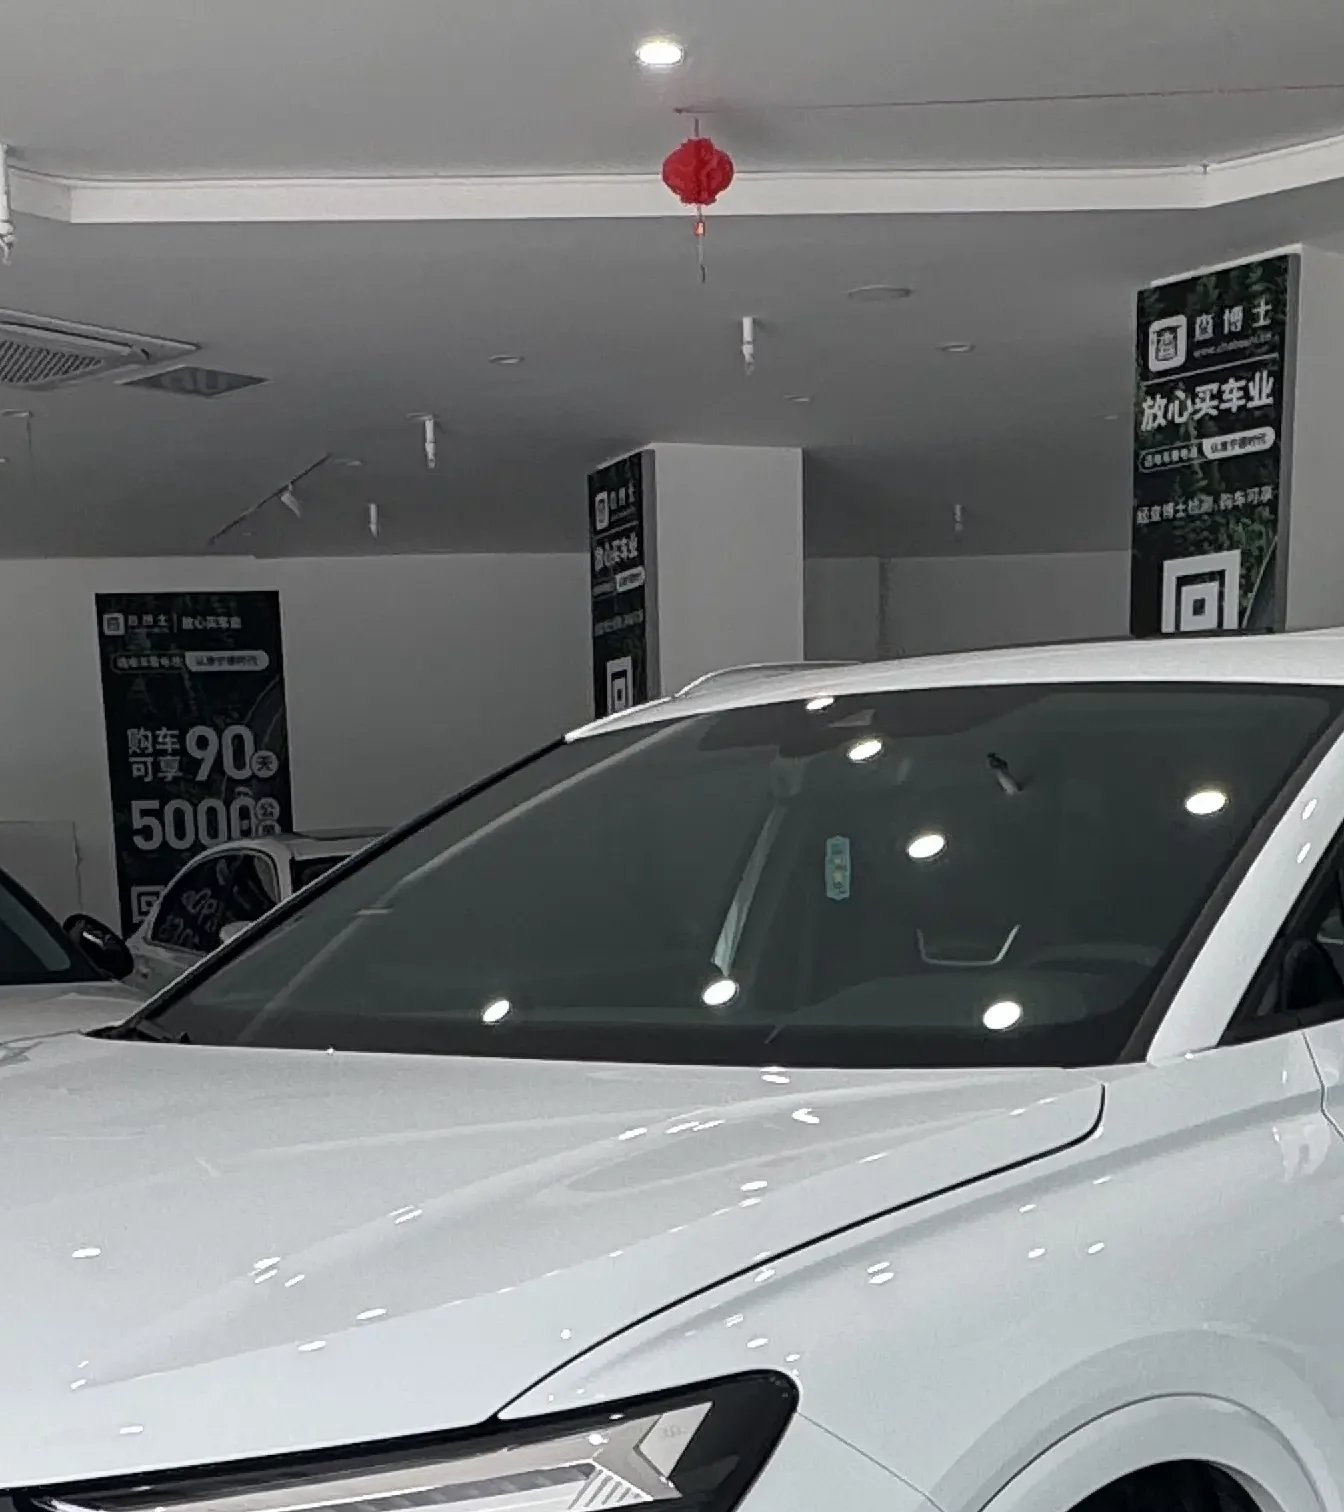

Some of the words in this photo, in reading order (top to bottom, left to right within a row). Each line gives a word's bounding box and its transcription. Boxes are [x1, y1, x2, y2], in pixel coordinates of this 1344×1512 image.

[1140, 370, 1275, 432] 放心买车业
[127, 727, 181, 756] 购车
